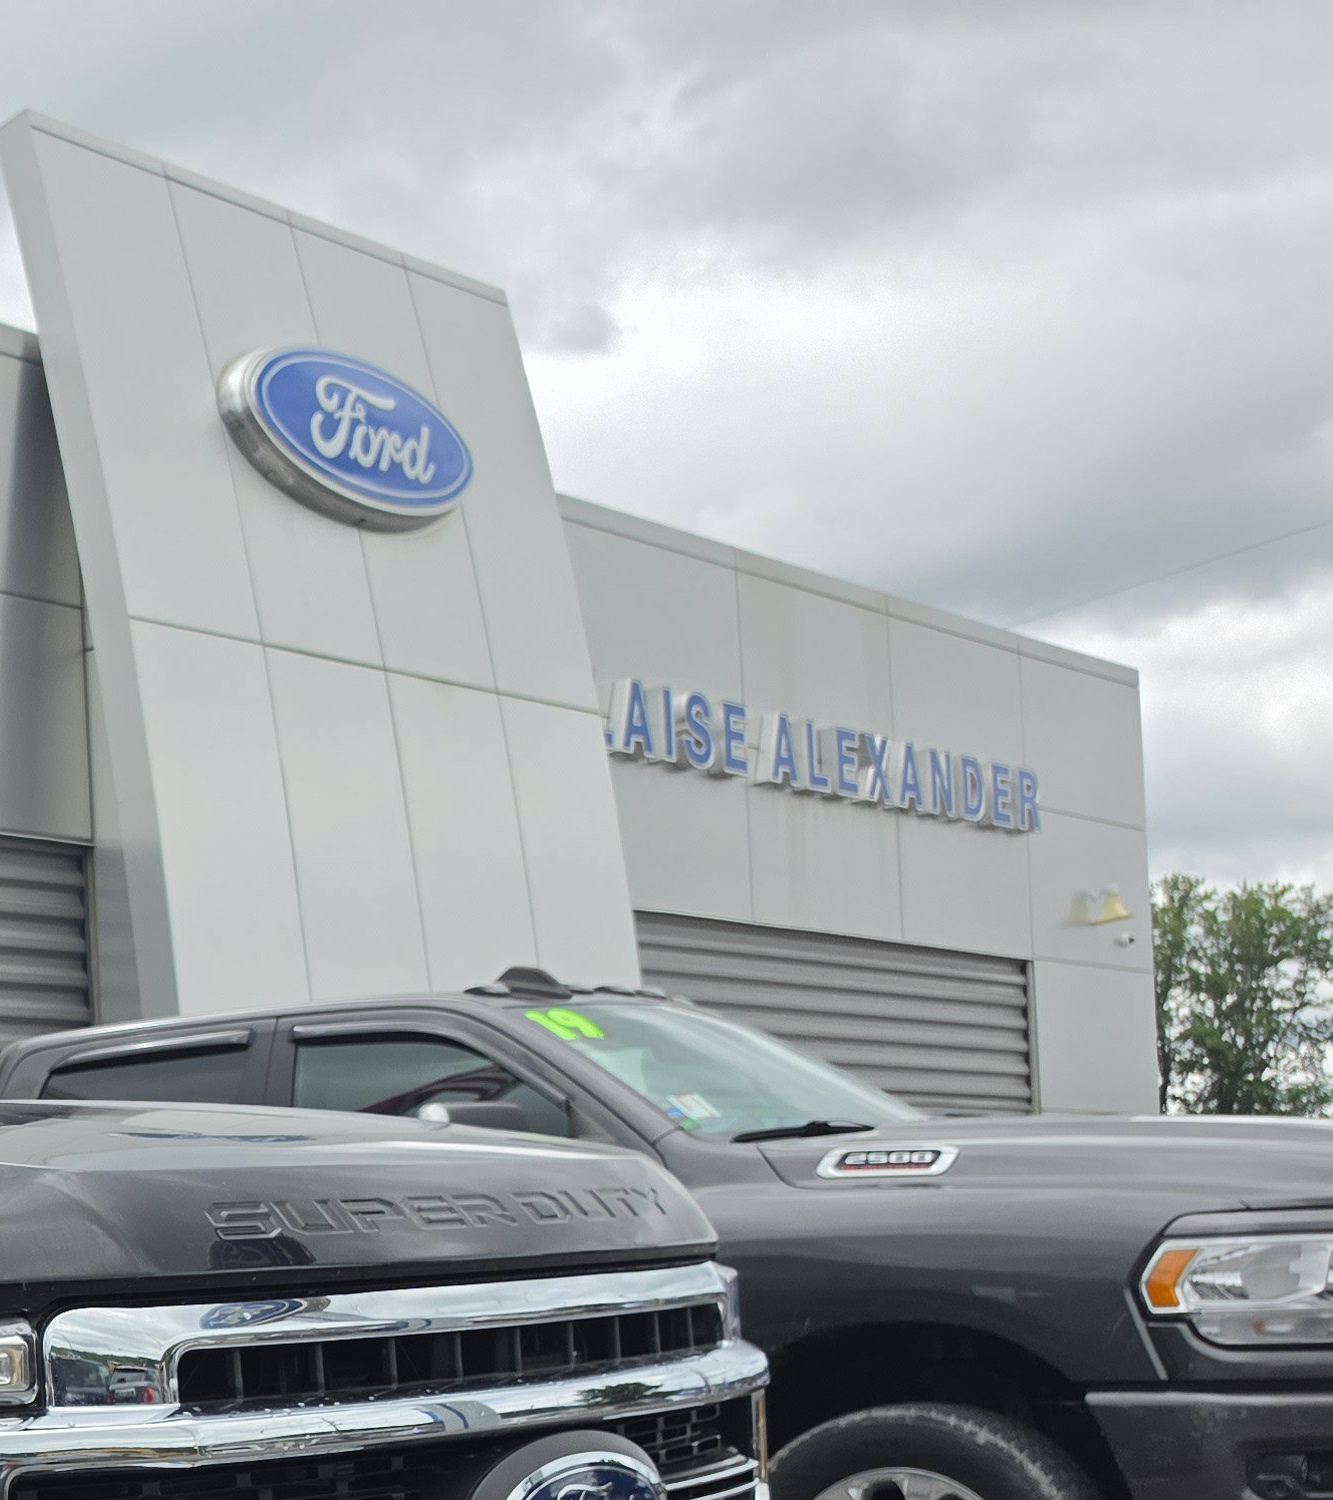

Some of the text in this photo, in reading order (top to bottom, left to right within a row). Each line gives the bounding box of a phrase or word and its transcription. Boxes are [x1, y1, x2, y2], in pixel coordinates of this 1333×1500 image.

[310, 374, 435, 485] Ford
[605, 679, 1041, 833] AISE ALEXANDER
[523, 1007, 606, 1041] 19
[844, 1151, 933, 1165] 2500
[204, 1187, 667, 1241] SUPER DUTY
